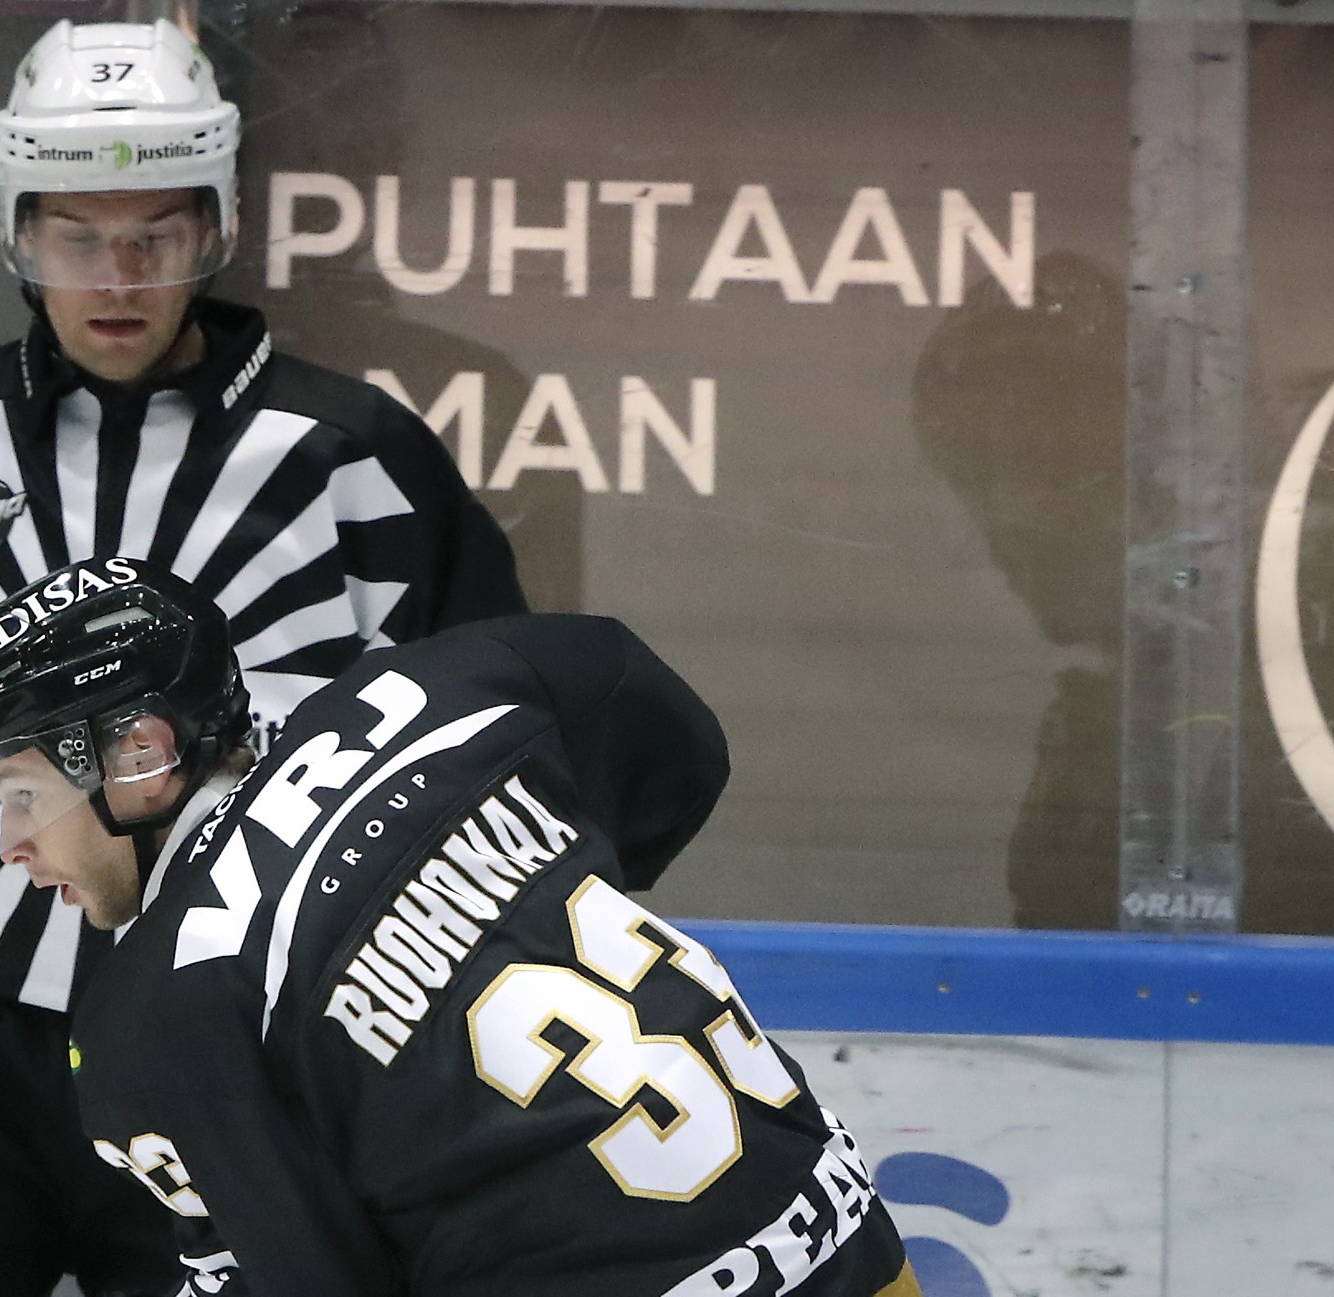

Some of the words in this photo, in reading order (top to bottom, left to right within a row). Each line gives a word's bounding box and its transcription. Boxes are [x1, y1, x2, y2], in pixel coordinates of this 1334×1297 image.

[91, 63, 134, 83] 37
[38, 144, 93, 161] intrum
[137, 141, 194, 164] justitia
[269, 171, 1037, 310] PUHTAAN
[73, 659, 123, 686] CCM
[173, 669, 428, 971] VRJ
[320, 773, 427, 895] GROUP
[466, 873, 801, 1204] 33
